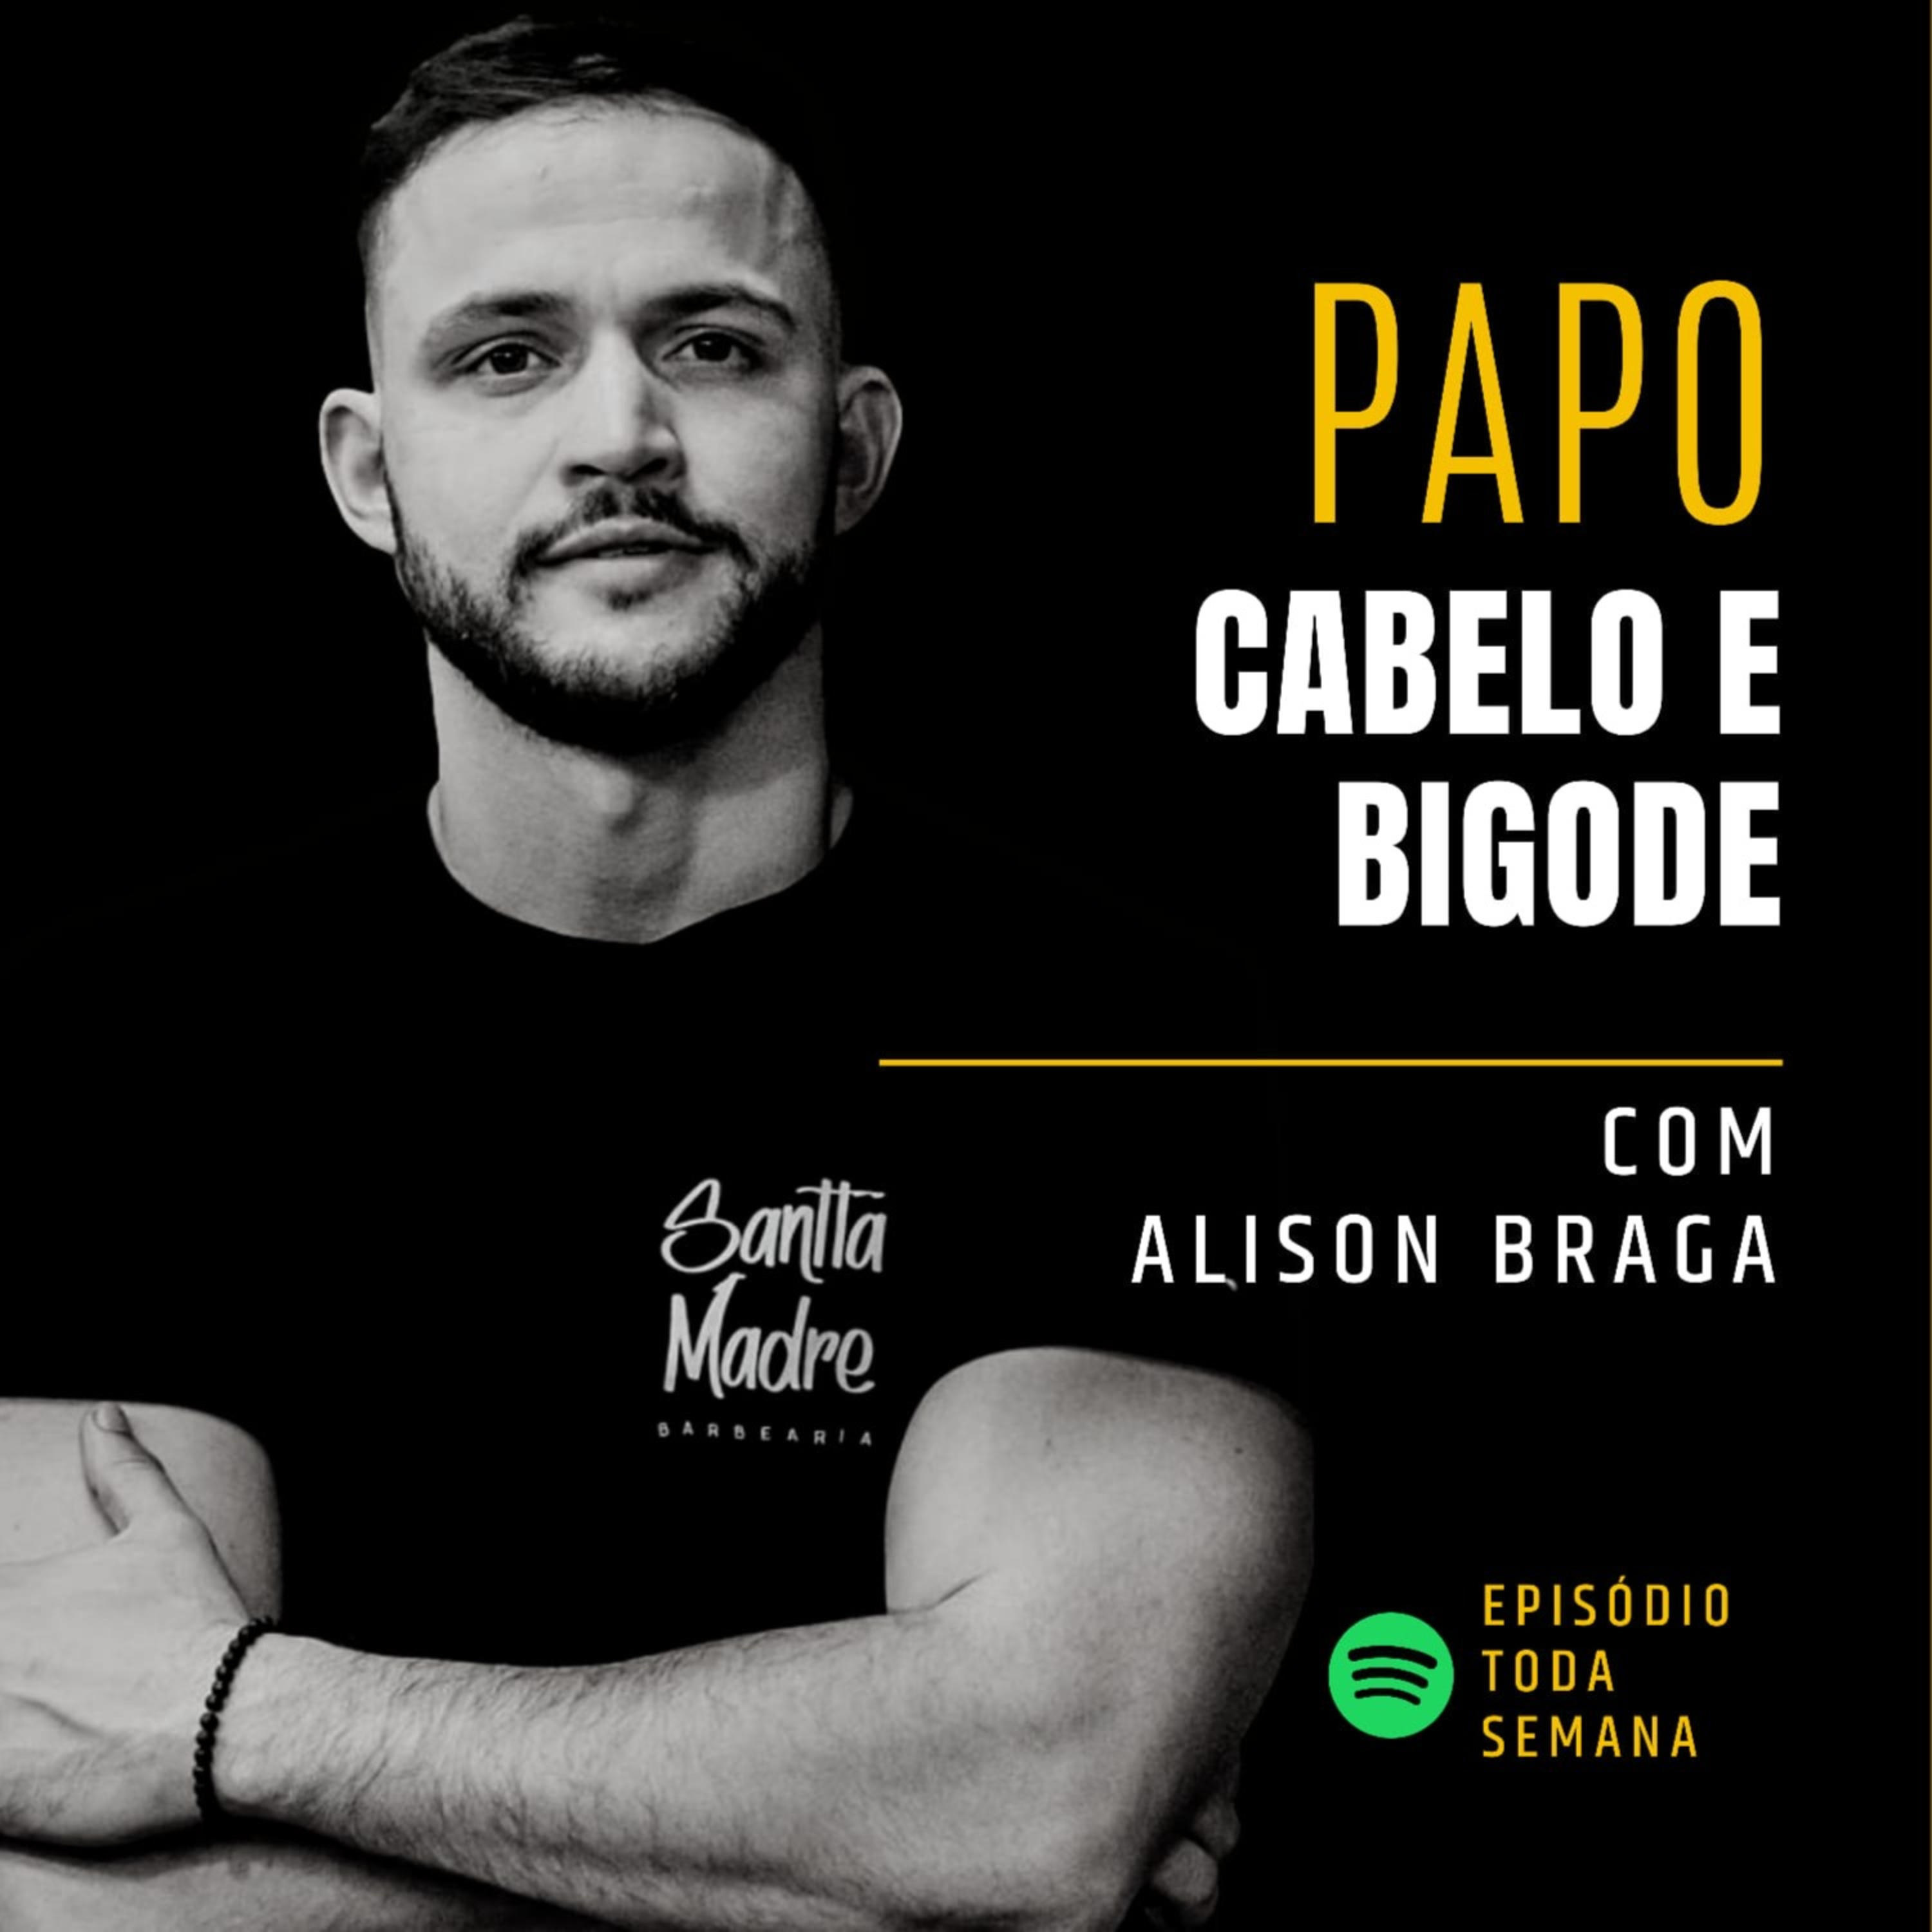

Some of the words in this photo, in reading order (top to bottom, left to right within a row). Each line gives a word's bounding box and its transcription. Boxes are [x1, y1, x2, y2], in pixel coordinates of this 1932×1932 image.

[660, 1178, 887, 1284] Santta
[663, 1272, 875, 1399] Madre
[658, 1420, 872, 1446] BARBEARIA
